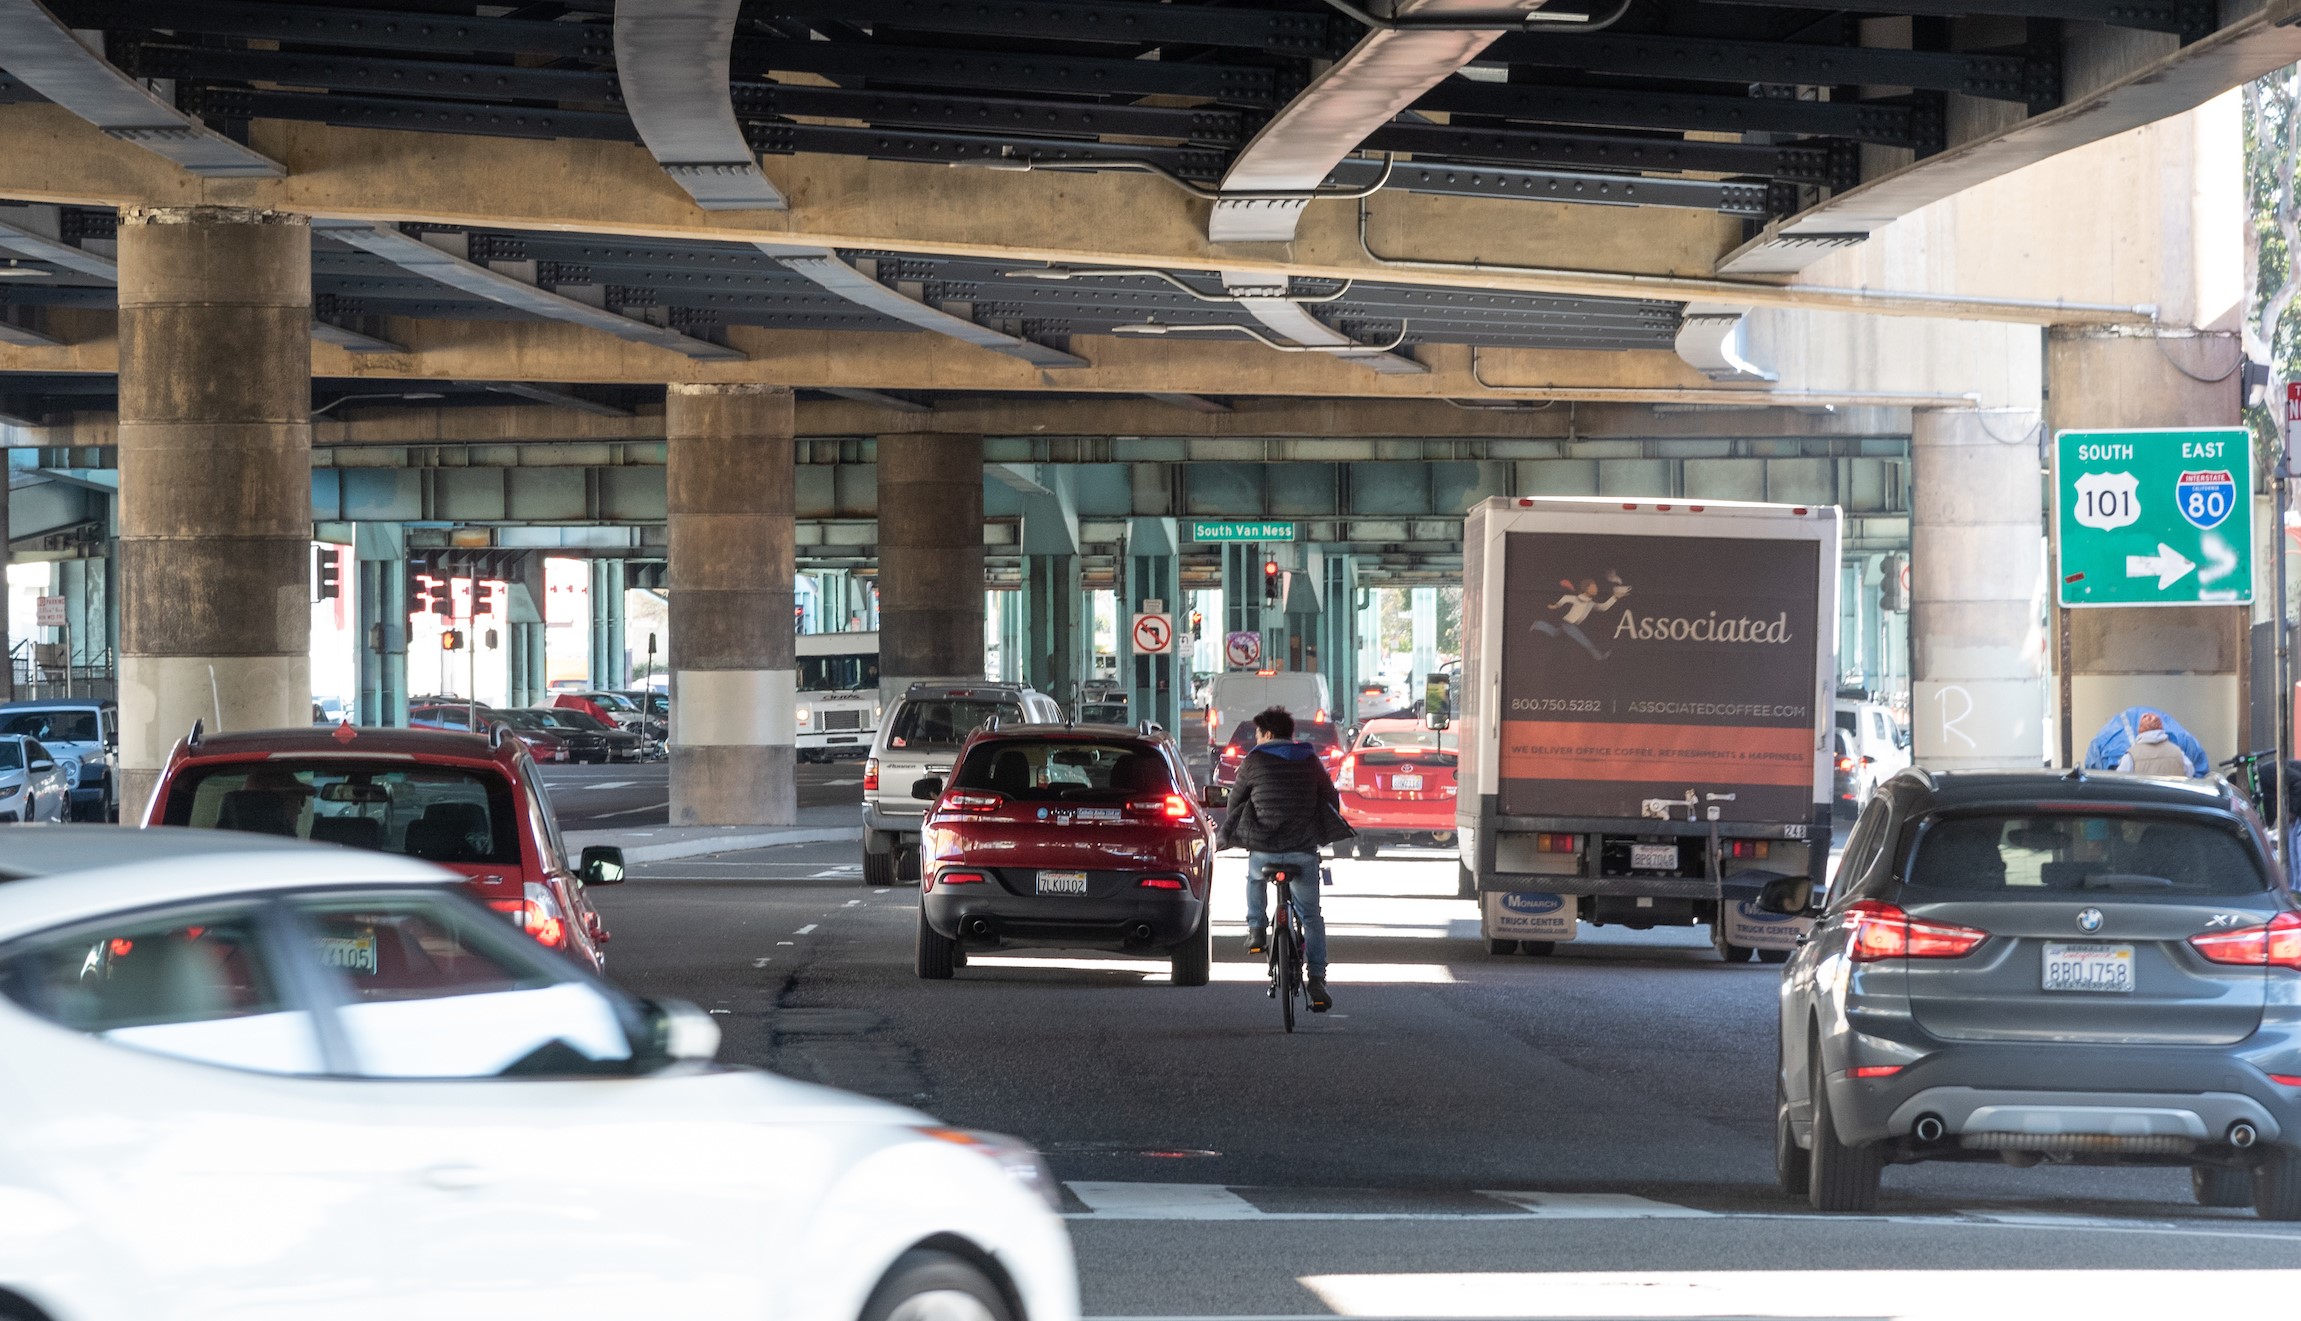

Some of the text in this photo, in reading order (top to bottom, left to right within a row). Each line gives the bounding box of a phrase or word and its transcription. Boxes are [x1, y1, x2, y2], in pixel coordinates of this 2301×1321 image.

[2078, 444, 2133, 461] SOUTH
[2182, 442, 2225, 459] EAST
[2185, 474, 2226, 482] INTERSTATE
[2085, 490, 2129, 517] 101
[2188, 492, 2225, 518] 80
[1196, 524, 1293, 537] South Van Ness
[1613, 608, 1793, 644] Associated
[1511, 698, 1806, 717] 800.750.5282 ASSOCIATEDCOFFEE.COM
[1934, 685, 1977, 748] R
[1511, 745, 1529, 754] WE
[1531, 746, 1573, 755] DELIVER
[1575, 746, 1612, 756] OFFICE
[1658, 748, 1736, 759] REFRESHMENTS
[1748, 751, 1804, 761] HAPPINESS
[1040, 879, 1084, 893] 7LKU102
[1507, 894, 1558, 908] MONARCH
[1500, 916, 1565, 926] TRUCK CENTER
[2204, 914, 2240, 927] X1
[1736, 924, 1764, 934] TRUCK
